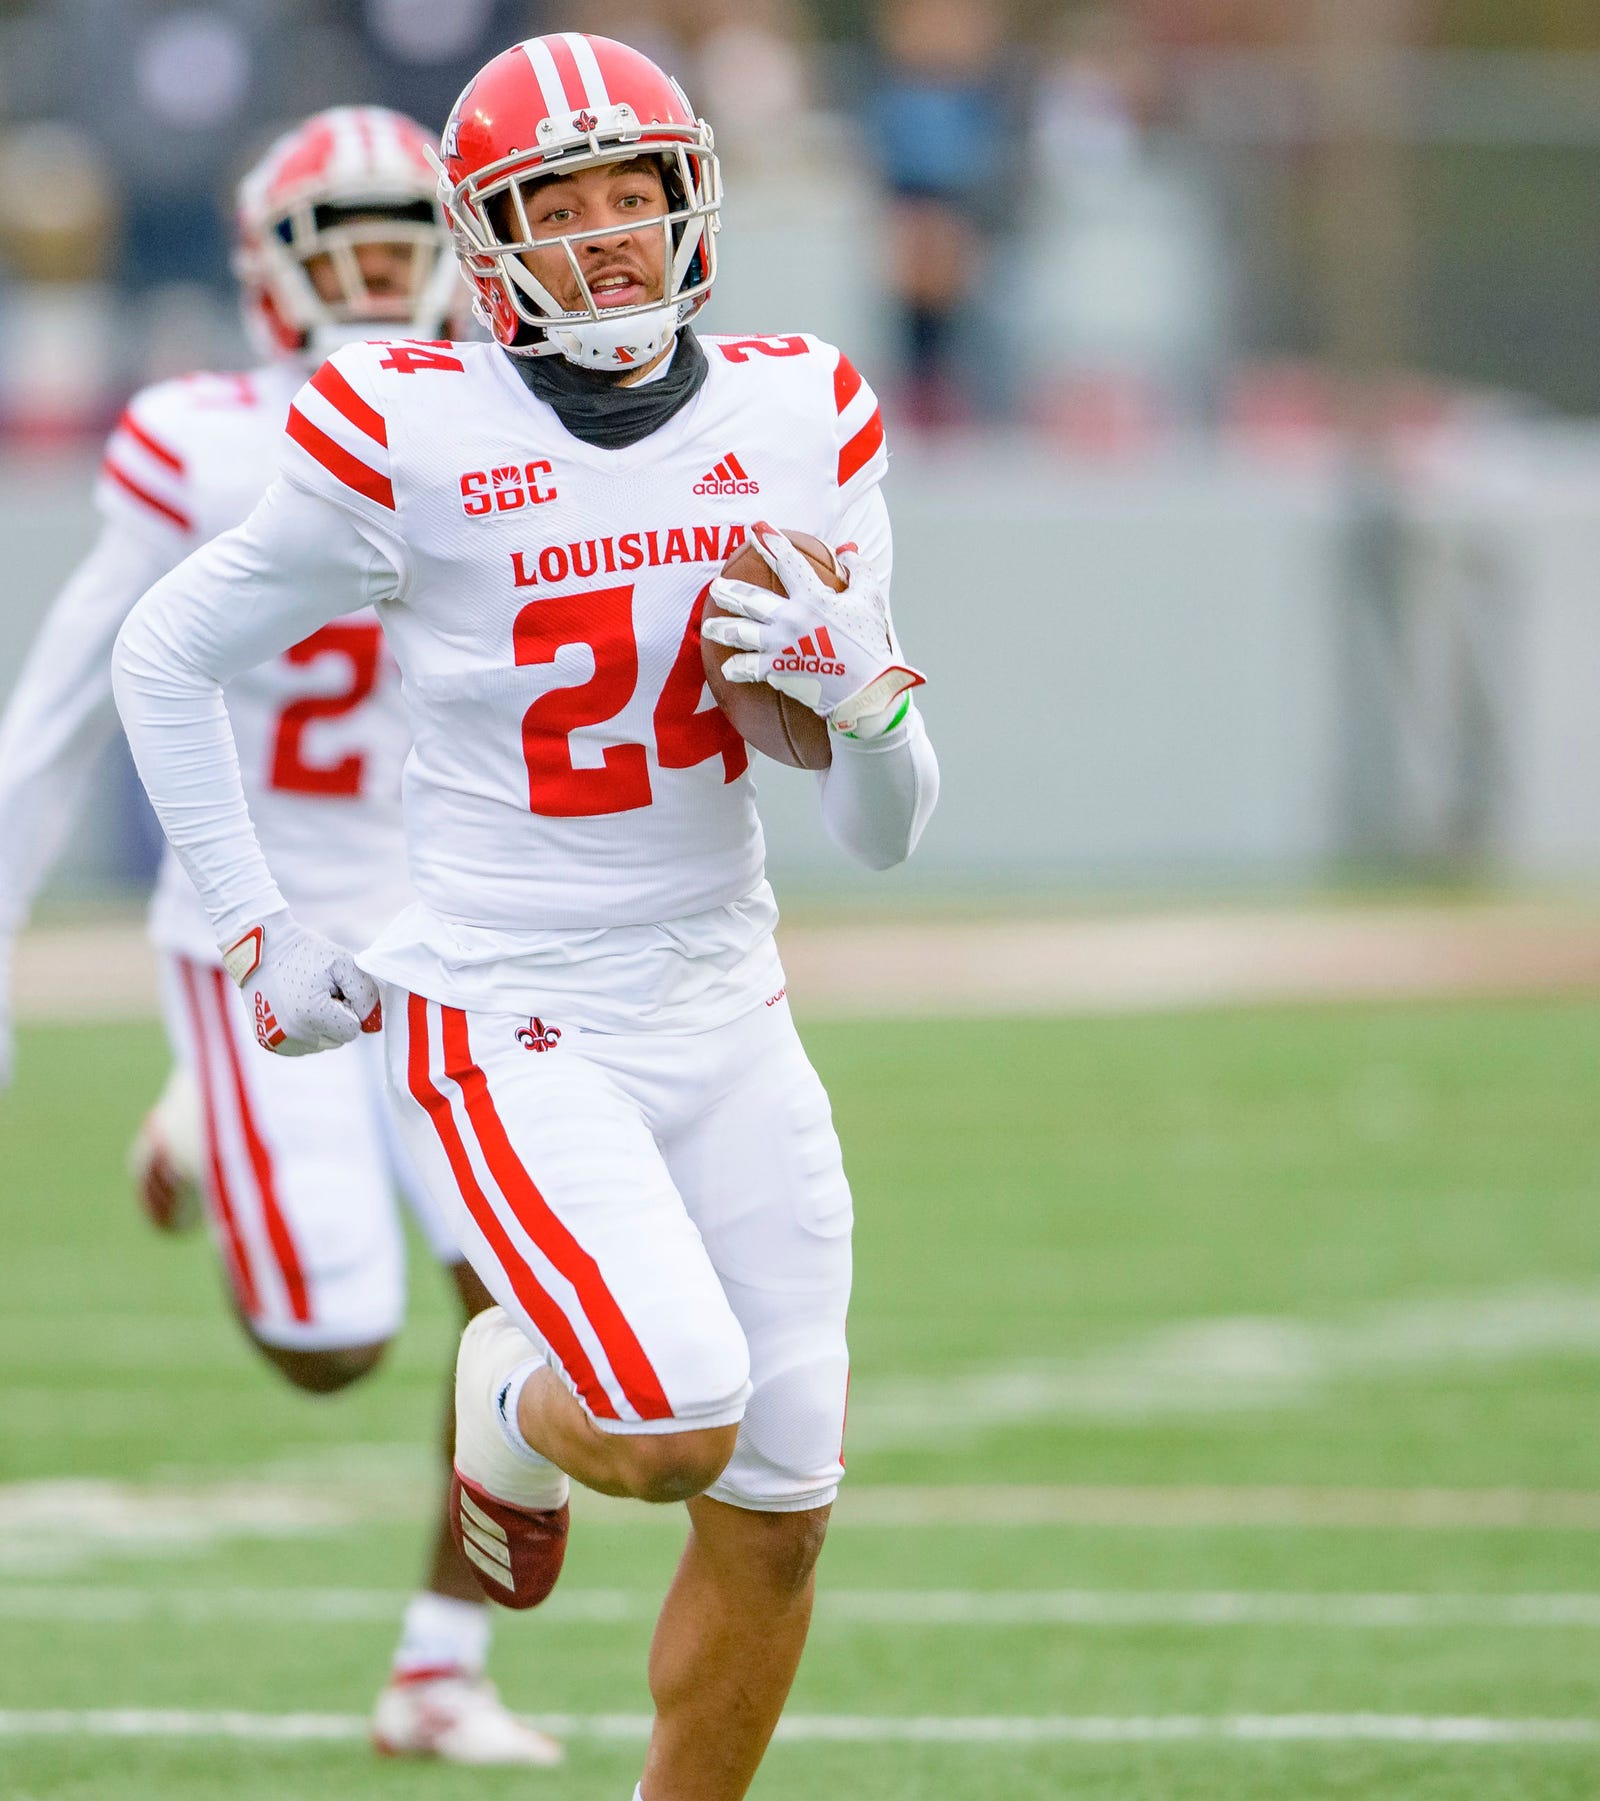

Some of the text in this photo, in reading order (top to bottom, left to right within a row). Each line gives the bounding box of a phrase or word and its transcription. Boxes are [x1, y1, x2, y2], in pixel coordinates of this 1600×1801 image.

[459, 459, 558, 516] SBC
[692, 479, 760, 496] adidas
[509, 525, 748, 588] LOUISIANA
[772, 654, 846, 676] adidas
[269, 620, 383, 797] 2
[255, 991, 277, 1053] adida
